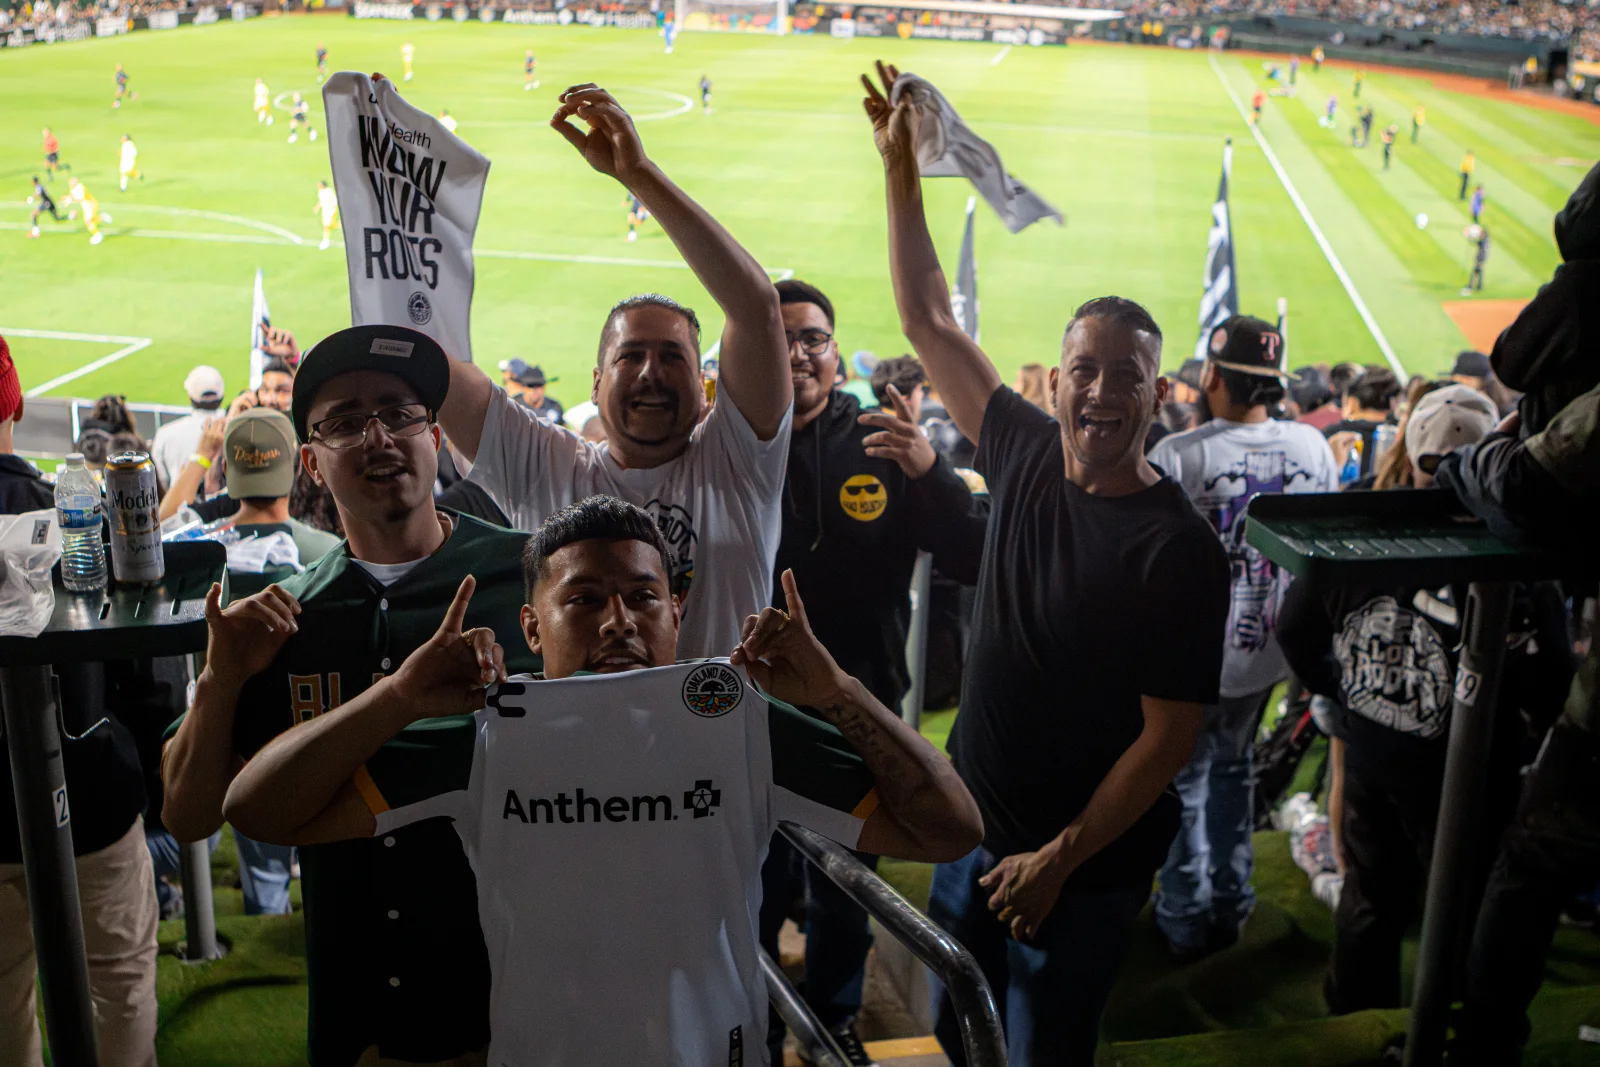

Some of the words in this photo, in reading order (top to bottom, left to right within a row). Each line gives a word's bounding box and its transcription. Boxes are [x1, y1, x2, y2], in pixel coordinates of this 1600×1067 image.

[364, 227, 442, 290] ROS
[111, 486, 158, 510] Model
[686, 667, 718, 693] OAKLAND
[719, 669, 739, 693] ROOTS
